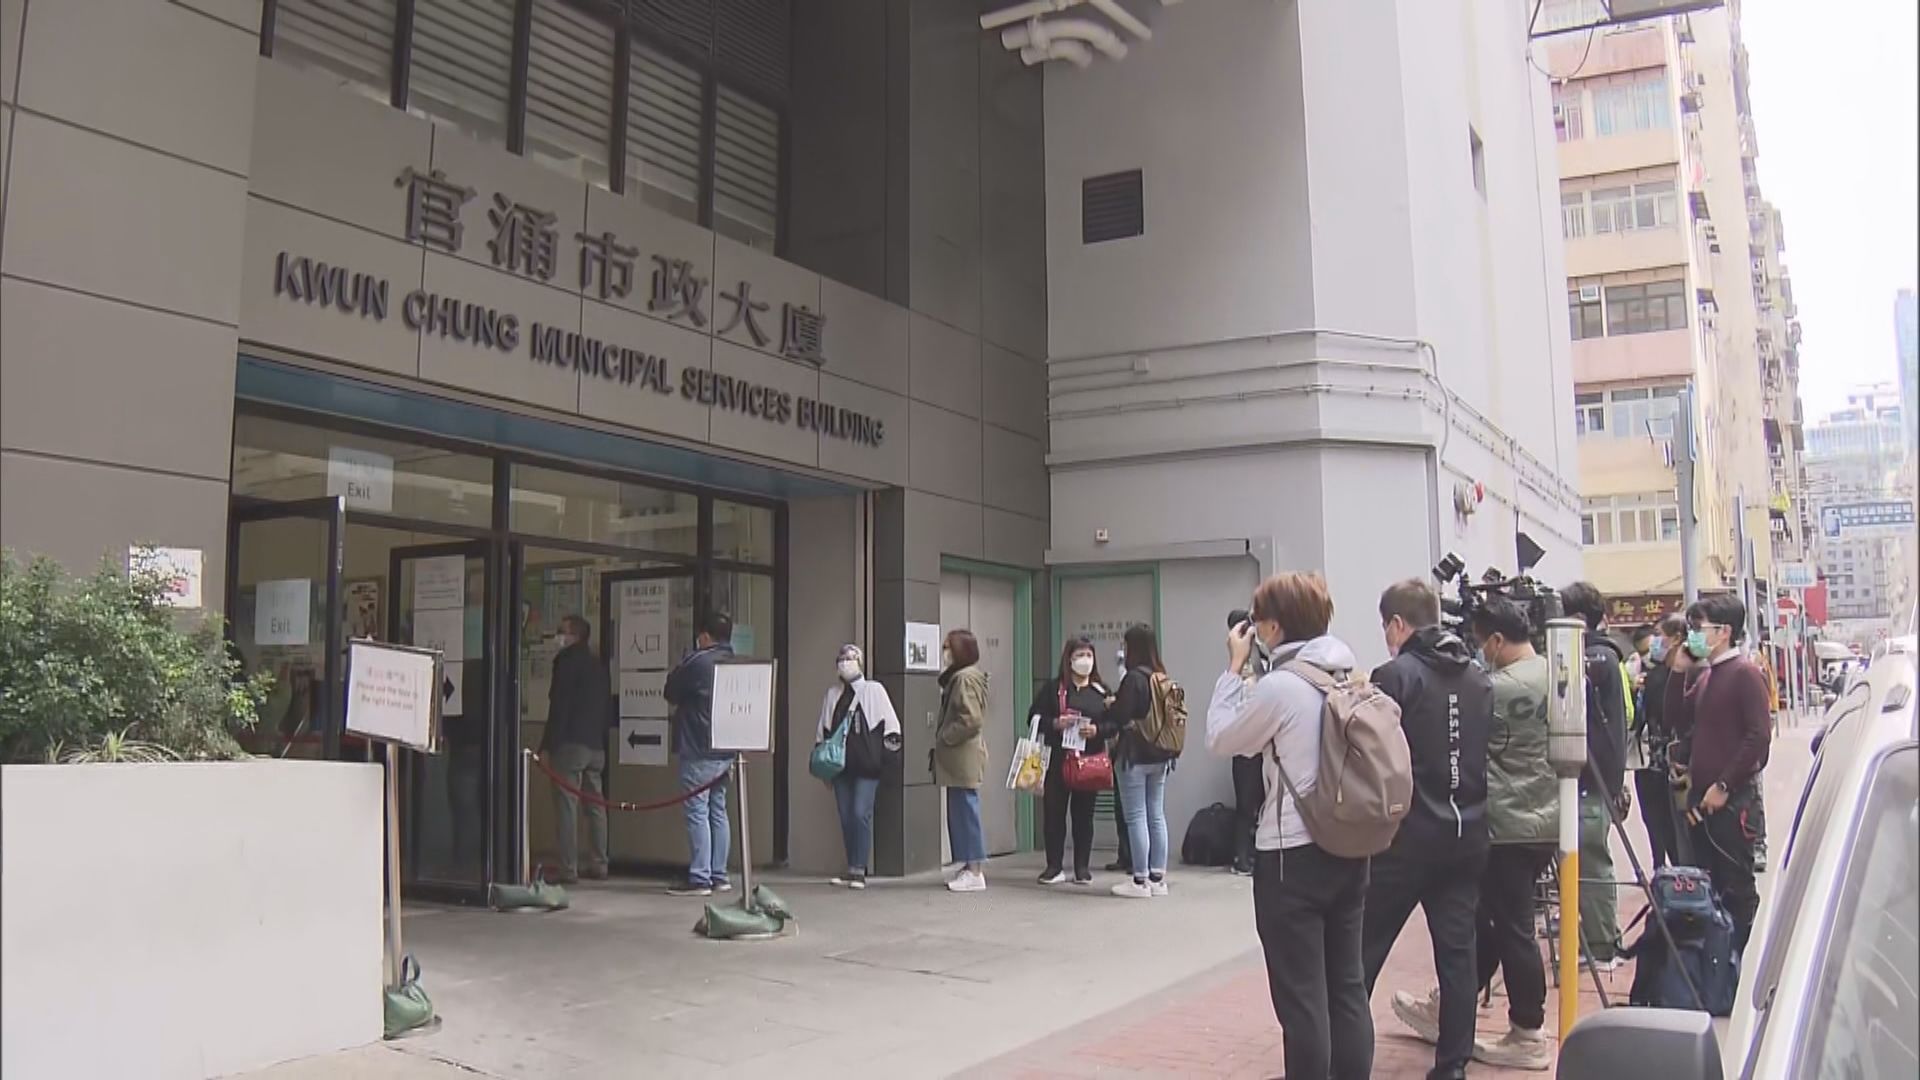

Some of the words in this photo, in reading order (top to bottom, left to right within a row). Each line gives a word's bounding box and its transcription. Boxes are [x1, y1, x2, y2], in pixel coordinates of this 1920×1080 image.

[275, 252, 388, 320] KWUN
[403, 289, 518, 352] CHUNG
[531, 321, 673, 396] MUNICIPAL
[681, 366, 791, 425] SERVICES
[796, 394, 886, 448] BUILDING
[347, 481, 370, 500] Exit
[271, 617, 291, 635] Exit
[629, 631, 660, 654] 入口
[730, 700, 752, 715] Exit
[1448, 693, 1460, 743] B.E.S.T.
[1449, 747, 1460, 790] Team
